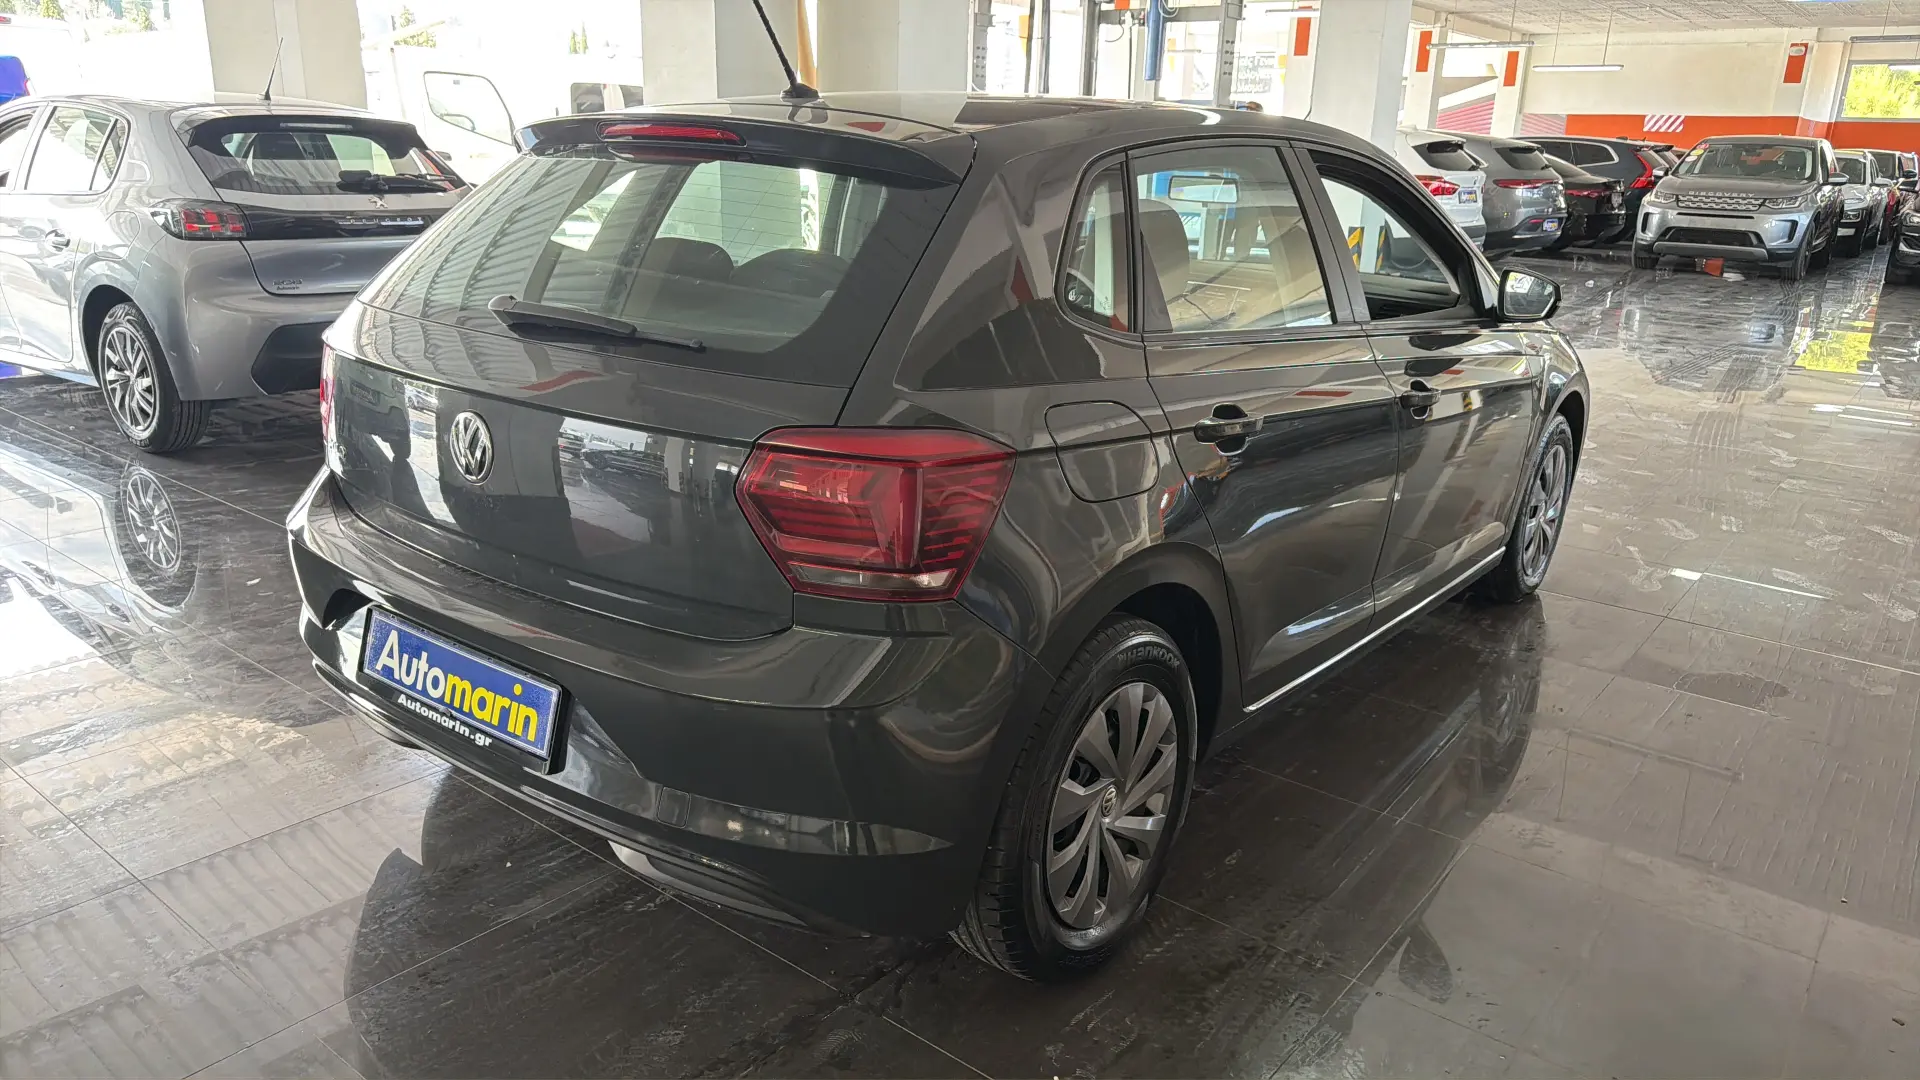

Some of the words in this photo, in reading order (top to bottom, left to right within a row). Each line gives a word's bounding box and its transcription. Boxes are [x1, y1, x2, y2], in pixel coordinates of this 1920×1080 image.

[1688, 190, 1755, 198] DISCOVERY
[375, 629, 539, 743] Automarin
[397, 693, 492, 747] Automarin.gr
